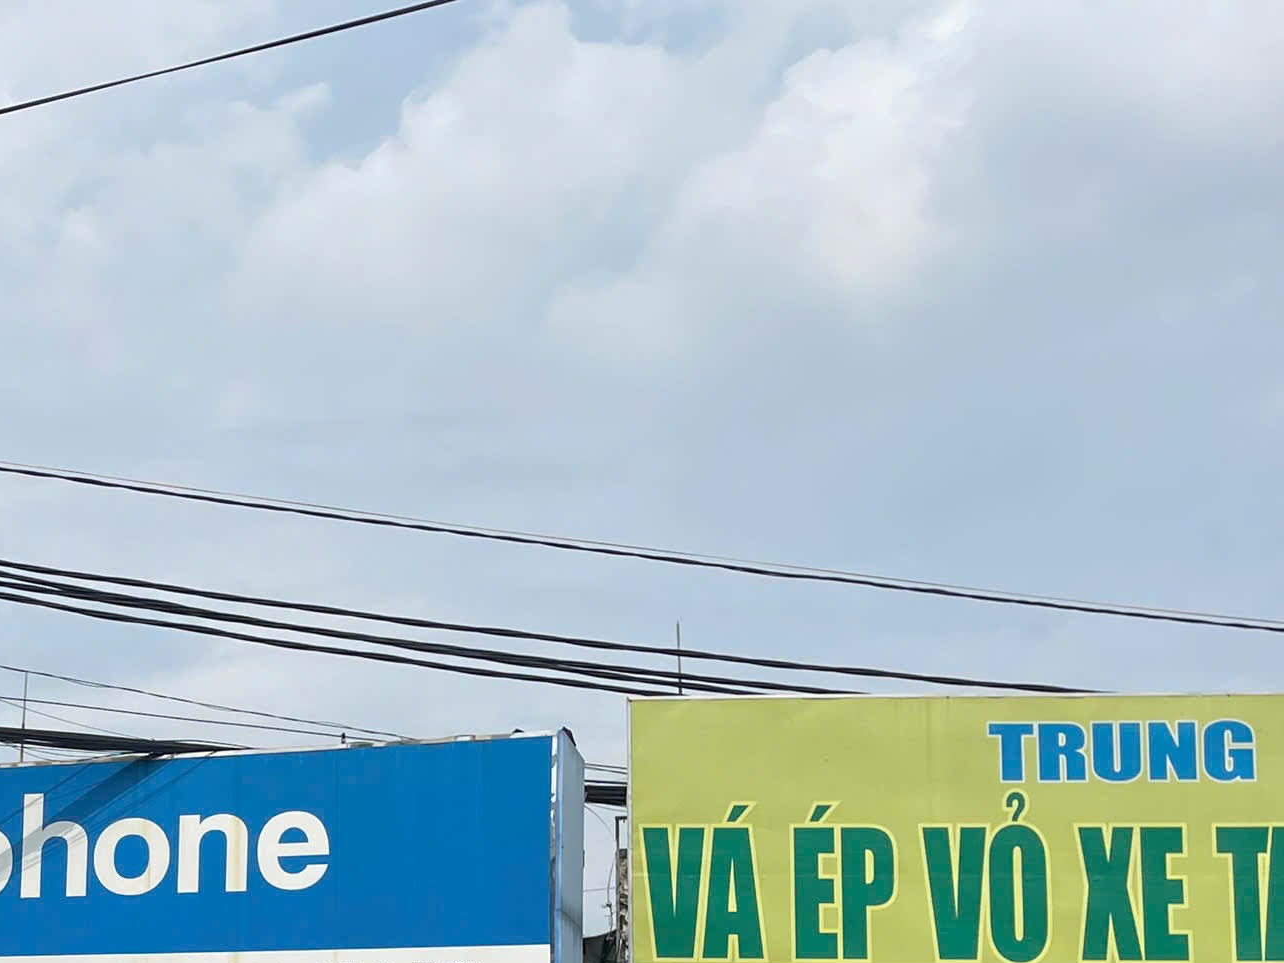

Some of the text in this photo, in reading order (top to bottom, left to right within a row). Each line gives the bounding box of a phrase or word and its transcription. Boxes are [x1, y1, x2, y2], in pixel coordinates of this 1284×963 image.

[988, 720, 1257, 783] TRUNG
[639, 801, 769, 963] VÁ
[789, 801, 898, 963] ÉP
